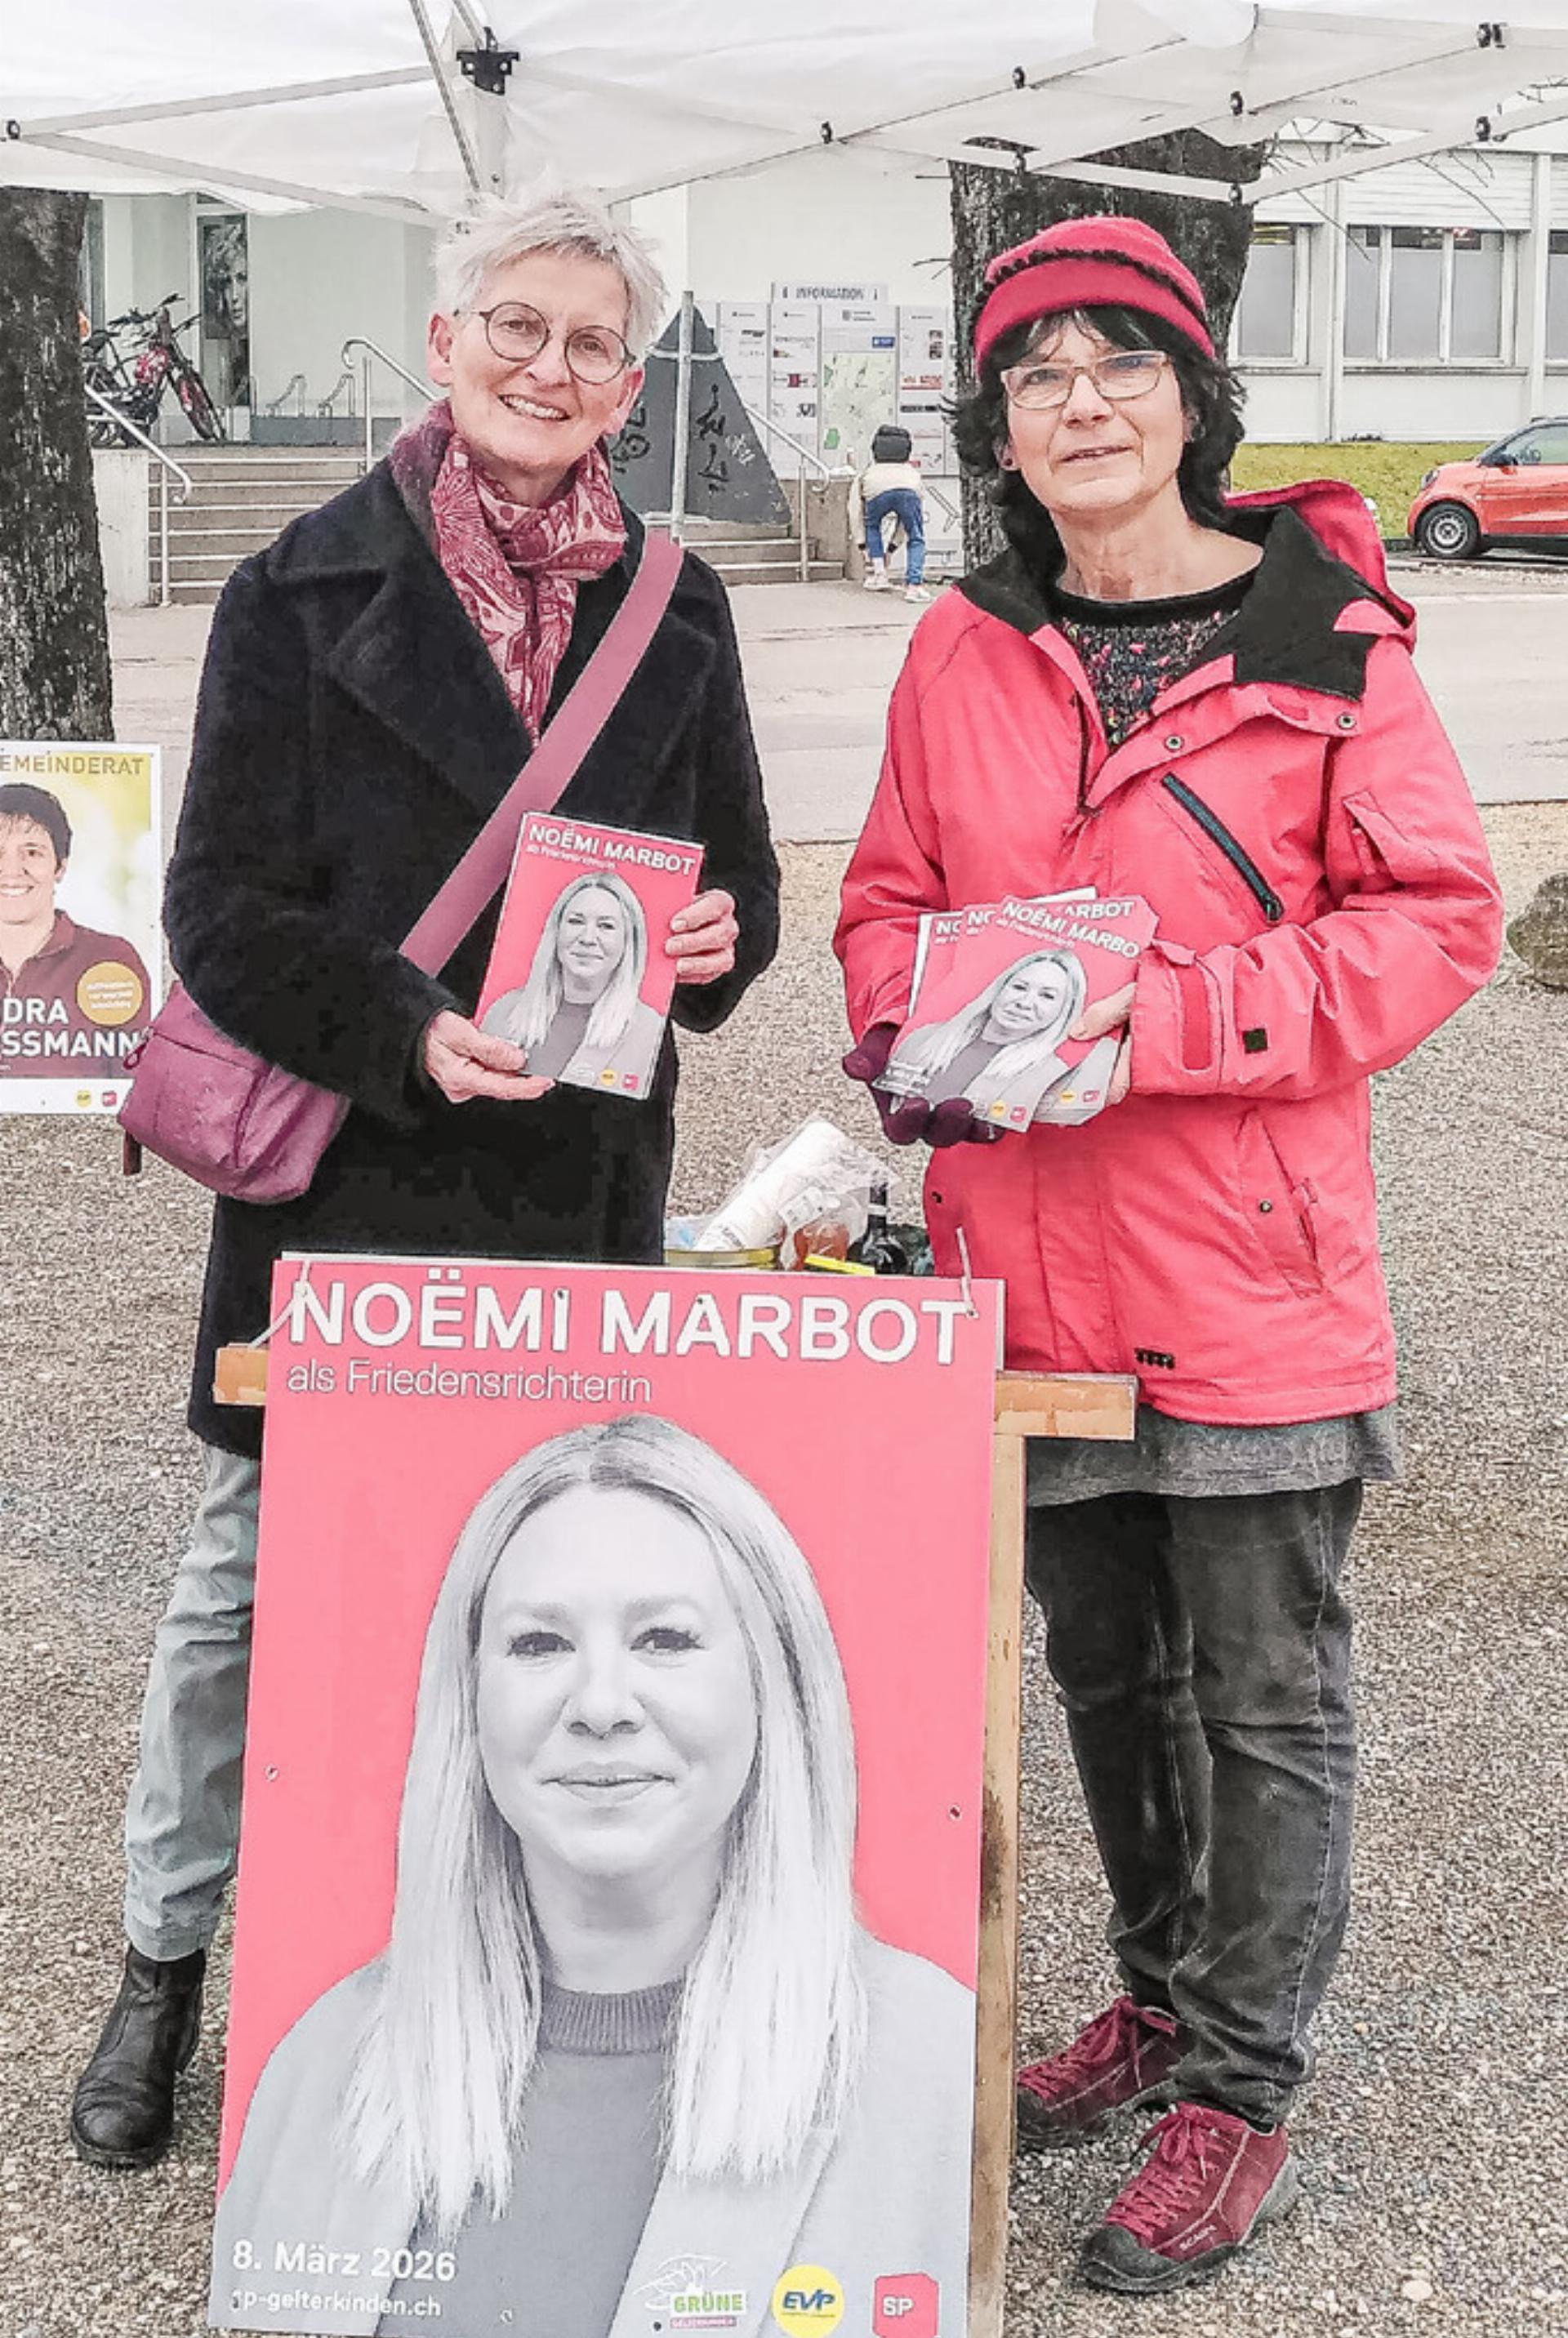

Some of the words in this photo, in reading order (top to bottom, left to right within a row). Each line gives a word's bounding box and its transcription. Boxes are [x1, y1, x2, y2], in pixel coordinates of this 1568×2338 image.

[796, 287, 864, 300] INFORMATION
[604, 841, 696, 875] MARBOT
[3, 998, 69, 1024] DRA
[290, 1268, 570, 1352] NOËMI
[601, 1289, 973, 1365] MARBOT
[287, 1359, 336, 1393] als
[347, 1359, 652, 1403] Friedensrichterin
[233, 2241, 262, 2270] 8.
[274, 2242, 361, 2276] März
[371, 2248, 457, 2282] 2026
[674, 2291, 744, 2314] GRÜNE
[783, 2289, 835, 2311] EVP
[883, 2296, 914, 2316] SP
